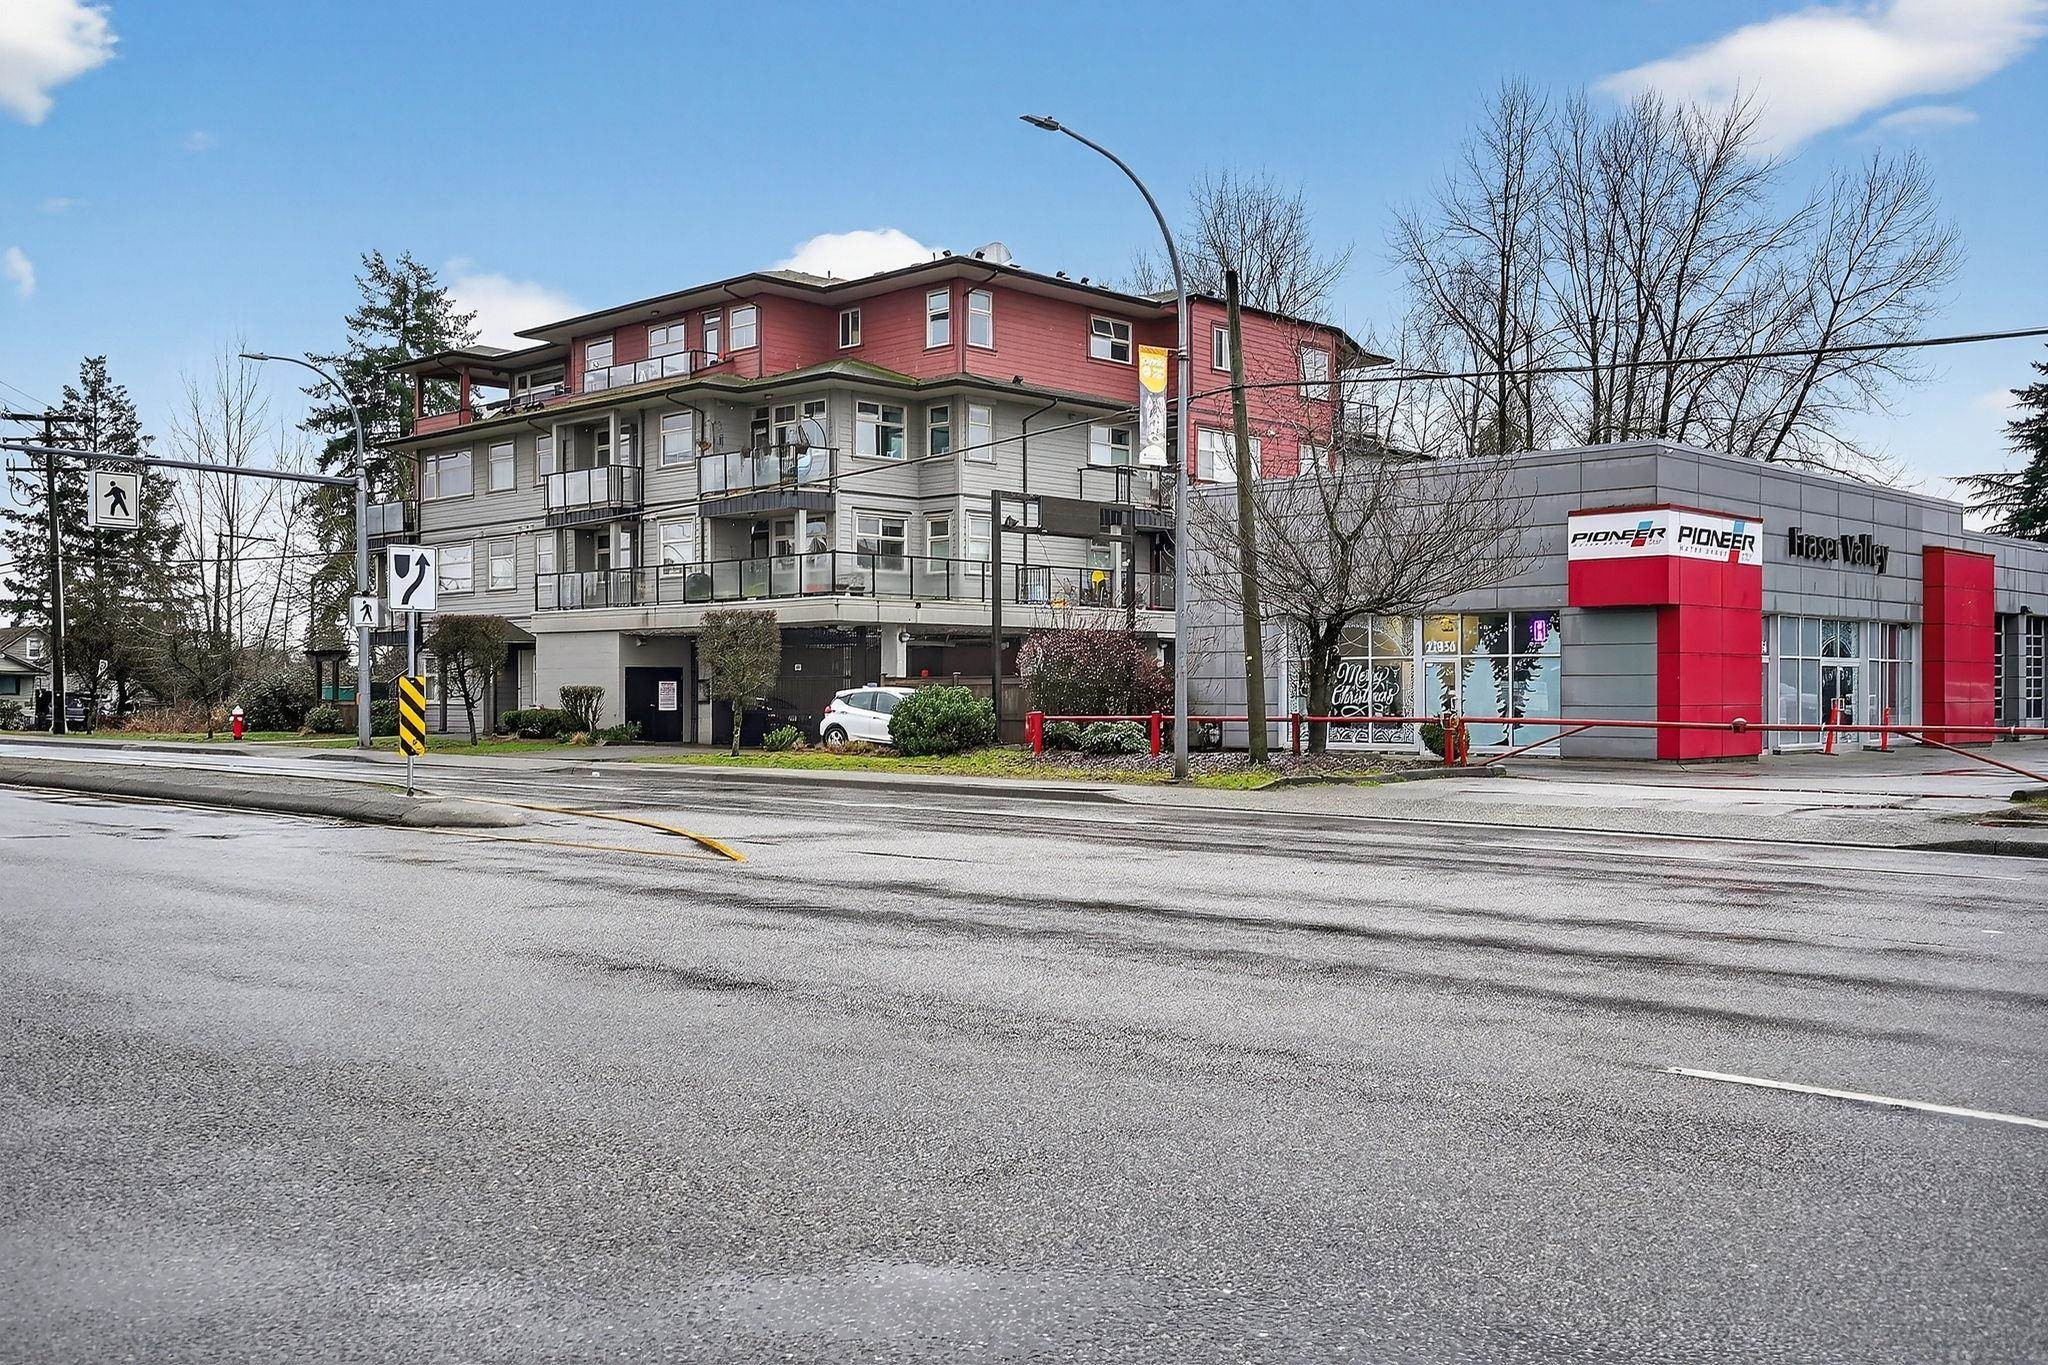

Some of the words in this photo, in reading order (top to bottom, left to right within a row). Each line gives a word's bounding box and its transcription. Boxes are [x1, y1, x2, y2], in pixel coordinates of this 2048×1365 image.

[1571, 527, 1667, 544] PIONEER
[1677, 525, 1755, 553] PIONEER
[1788, 526, 1840, 562] Fraser
[1840, 533, 1889, 575] Valley
[1331, 681, 1400, 706] Christmas
